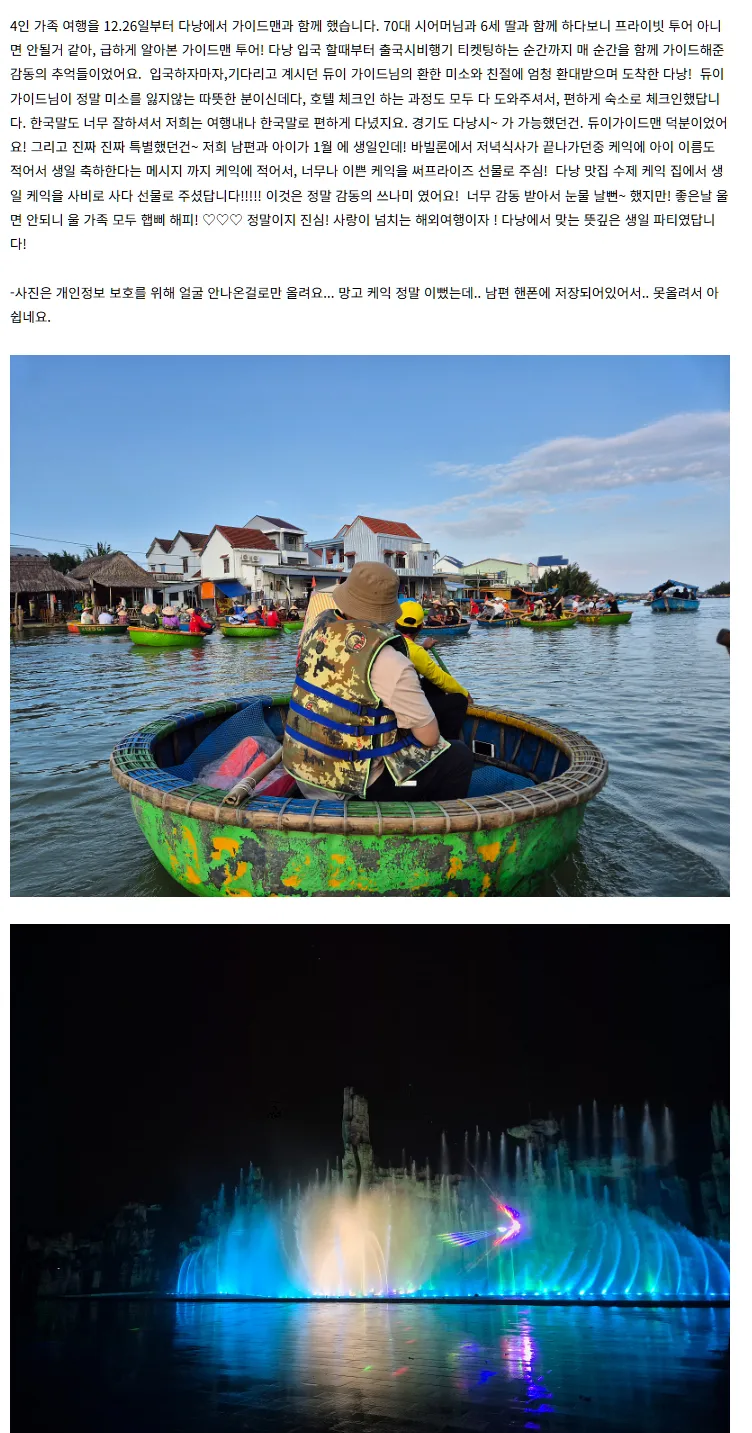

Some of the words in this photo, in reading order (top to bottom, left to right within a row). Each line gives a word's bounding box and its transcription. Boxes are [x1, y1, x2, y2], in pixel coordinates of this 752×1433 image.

[9, 19, 30, 33] 4인
[34, 19, 59, 33] 가족
[62, 19, 100, 33] 여행을
[103, 19, 174, 33] 12.26일부터
[178, 19, 227, 33] 다낭에서
[232, 19, 295, 33] 가이드맨과
[297, 19, 322, 33] 함께
[326, 19, 380, 33] 했습니다.
[383, 19, 411, 33] 70대
[414, 19, 477, 33] 시어머님과
[480, 19, 500, 33] 6세
[504, 19, 530, 33] 딸과
[532, 19, 558, 33] 함께
[561, 19, 611, 33] 하다보니
[615, 19, 665, 33] 프라이빗
[668, 19, 693, 33] 투어
[696, 19, 721, 33] 아니
[10, 43, 22, 57] 면
[26, 43, 63, 57] 안될거
[67, 43, 97, 58] 같아,
[99, 43, 137, 57] 급하게
[140, 43, 178, 57] 알아본
[182, 43, 231, 57] 가이드맨
[235, 43, 264, 57] 투어!
[268, 43, 294, 57] 다낭
[296, 43, 322, 57] 입국
[325, 43, 375, 57] 할때부터
[378, 43, 453, 57] 출국시비행기
[457, 43, 520, 57] 티켓팅하는
[522, 43, 572, 57] 순간까지
[576, 43, 589, 57] 매
[592, 43, 630, 57] 순간을
[633, 43, 659, 57] 함께
[662, 43, 725, 57] 가이드해준
[10, 92, 72, 106] 가이드님이
[76, 92, 102, 106] 정말
[104, 92, 142, 106] 미소를
[146, 92, 196, 106] 잃지않는
[199, 92, 237, 106] 따뜻한
[240, 92, 307, 107] 분이신데다,
[309, 92, 335, 106] 호텔
[338, 92, 376, 106] 체크인
[379, 92, 405, 106] 하는
[407, 92, 446, 106] 과정도
[449, 92, 474, 106] 모두
[478, 92, 491, 106] 다
[493, 92, 560, 107] 도와주셔서,
[563, 92, 601, 106] 편하게
[604, 92, 642, 106] 숙소로
[645, 92, 720, 106] 체크인했답니
[10, 140, 27, 153] 요!
[30, 140, 68, 154] 그리고
[72, 140, 97, 154] 진짜
[100, 140, 126, 154] 진짜
[128, 140, 199, 154] 특별했던건~
[202, 140, 227, 154] 저희
[231, 140, 269, 154] 남편과
[271, 140, 310, 154] 아이가
[313, 140, 333, 154] 1월
[336, 140, 349, 154] 에
[353, 140, 407, 154] 생일인데!
[411, 140, 472, 154] 바빌론에서
[476, 140, 540, 154] 저녁식사가
[542, 140, 605, 154] 끝나가던중
[608, 140, 646, 154] 케익에
[649, 140, 674, 154] 아이
[678, 140, 716, 154] 이름도
[10, 164, 47, 178] 적어서
[51, 164, 76, 178] 생일
[79, 164, 142, 178] 축하한다는
[146, 164, 182, 178] 메시지
[186, 164, 211, 178] 까지
[215, 164, 253, 178] 케익에
[256, 164, 298, 179] 적어서,
[301, 164, 339, 178] 너무나
[342, 164, 367, 178] 이쁜
[370, 164, 409, 178] 케익을
[411, 164, 474, 178] 써프라이즈
[477, 164, 515, 178] 선물로
[518, 164, 548, 178] 주심!
[555, 164, 581, 178] 다낭
[584, 164, 608, 178] 맛집
[612, 164, 638, 178] 수제
[641, 164, 666, 178] 케익
[670, 164, 707, 178] 집에서
[711, 164, 723, 178] 생
[10, 189, 22, 203] 일
[26, 189, 64, 203] 케익을
[67, 189, 105, 203] 사비로
[108, 189, 134, 203] 사다
[137, 189, 175, 203] 선물로
[266, 189, 303, 203] 이것은
[307, 189, 332, 203] 정말
[335, 189, 372, 203] 감동의
[376, 189, 413, 203] 쓰나미
[417, 189, 459, 203] 였어요!
[467, 189, 492, 203] 너무
[495, 189, 521, 203] 감동
[524, 189, 561, 203] 받아서
[564, 189, 590, 203] 눈물
[593, 189, 626, 203] 날뻔~
[629, 189, 671, 203] 했지만!
[674, 189, 713, 203] 좋은날
[715, 189, 729, 203] 울
[10, 237, 27, 251] 다!
[55, 286, 106, 300] 개인정보
[109, 286, 147, 300] 보호를
[150, 286, 175, 300] 위해
[179, 286, 204, 300] 얼굴
[207, 286, 283, 300] 안나온걸로만
[285, 286, 335, 300] 올려요...
[338, 286, 364, 300] 망고
[366, 286, 391, 300] 케익
[395, 286, 421, 300] 정말
[485, 286, 510, 300] 남편
[513, 286, 551, 300] 핸폰에
[554, 286, 649, 300] 저장되어있어서..
[652, 286, 702, 300] 못올려서
[706, 286, 720, 300] 아
[9, 310, 51, 324] 쉽네요.
